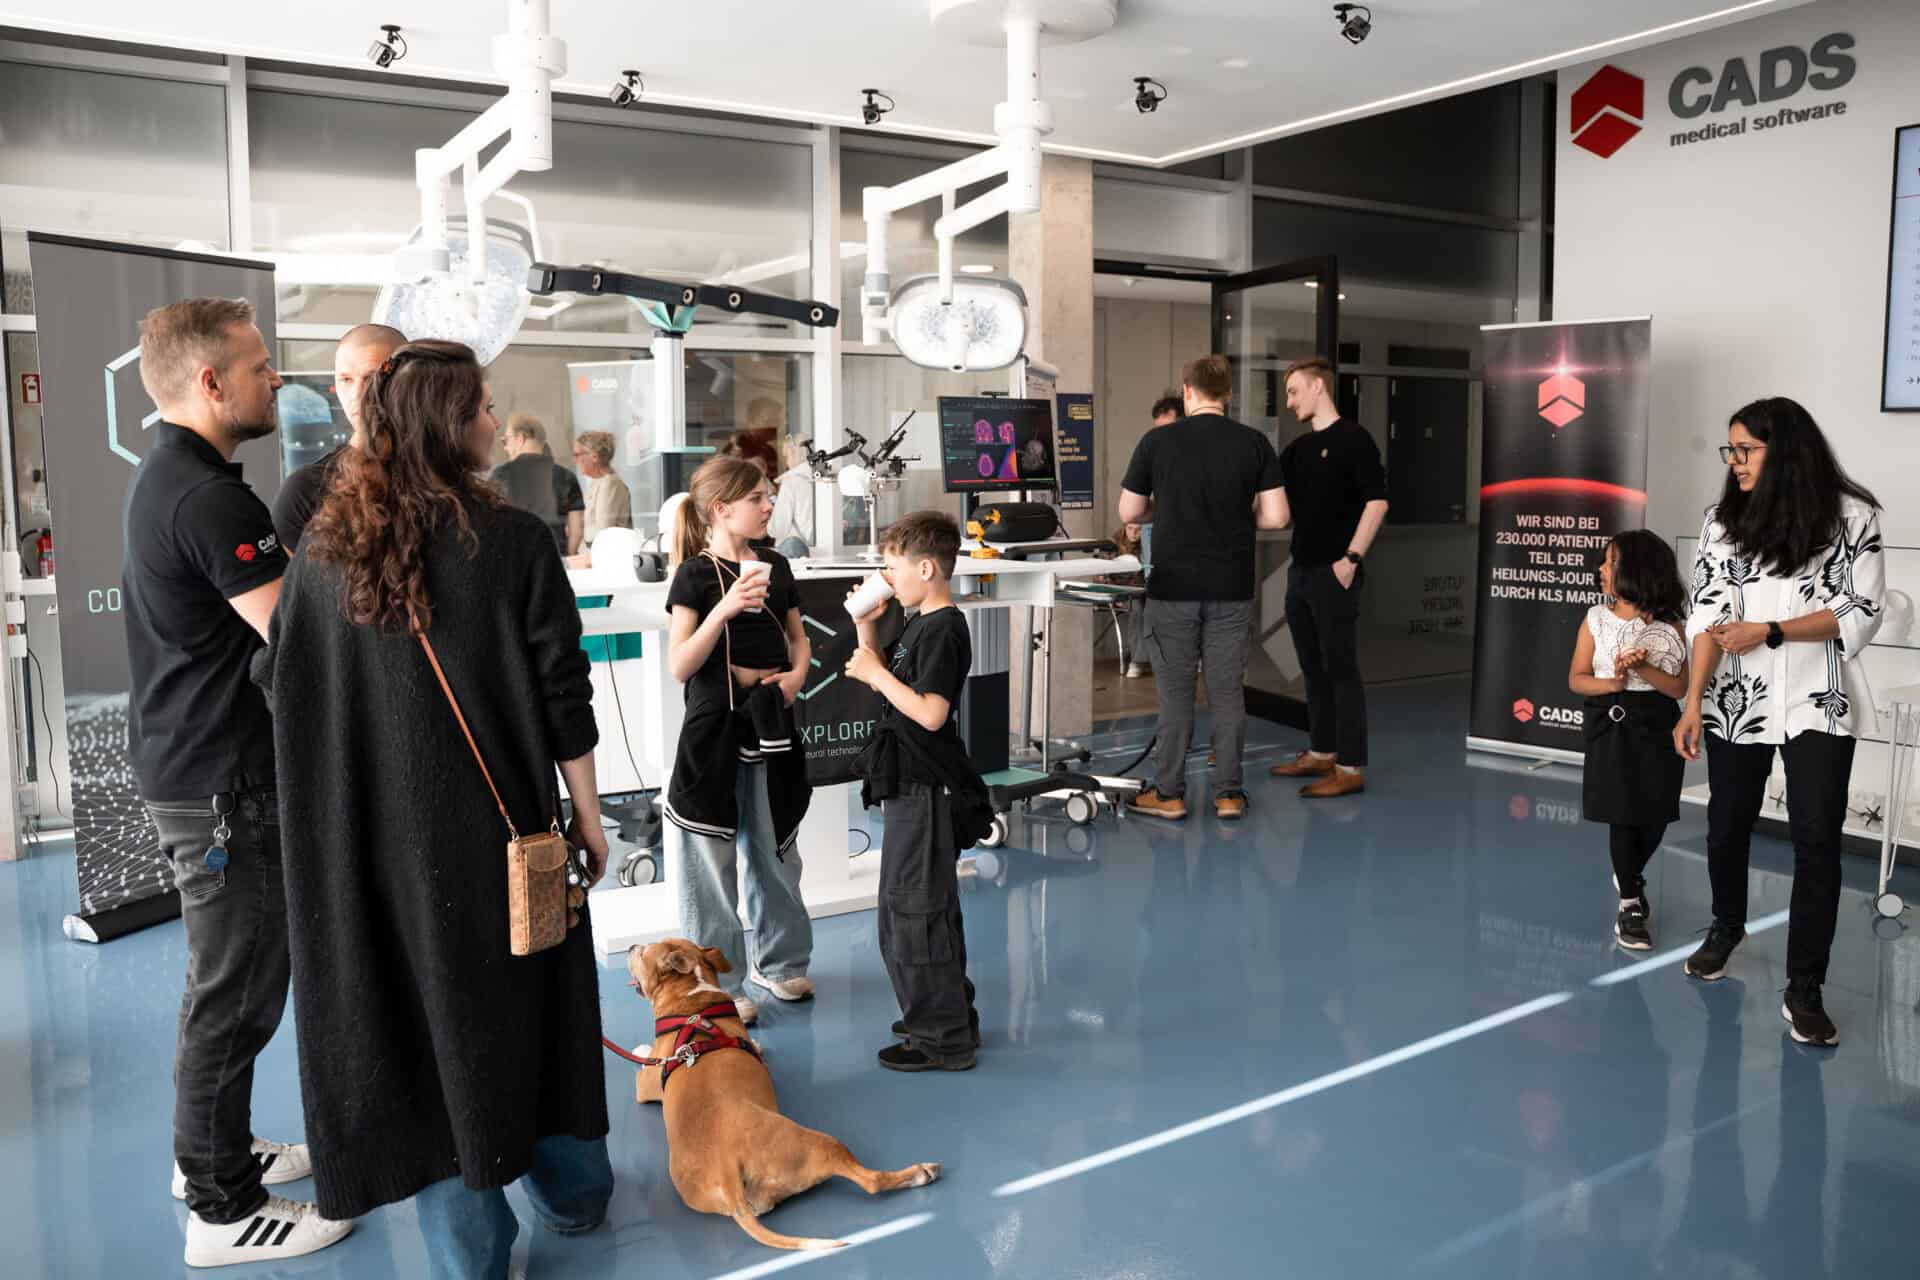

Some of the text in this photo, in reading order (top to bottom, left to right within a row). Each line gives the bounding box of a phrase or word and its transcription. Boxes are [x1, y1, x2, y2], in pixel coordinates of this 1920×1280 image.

[1668, 32, 1857, 119] CADS
[1670, 101, 1847, 147] medical software
[1516, 514, 1600, 530] WIR SIND BEI
[1496, 532, 1545, 546] 230.000
[1528, 551, 1585, 567] TEIL DER
[1490, 585, 1535, 600] DURCH
[1538, 588, 1563, 602] KLS
[1539, 706, 1584, 725] CADS
